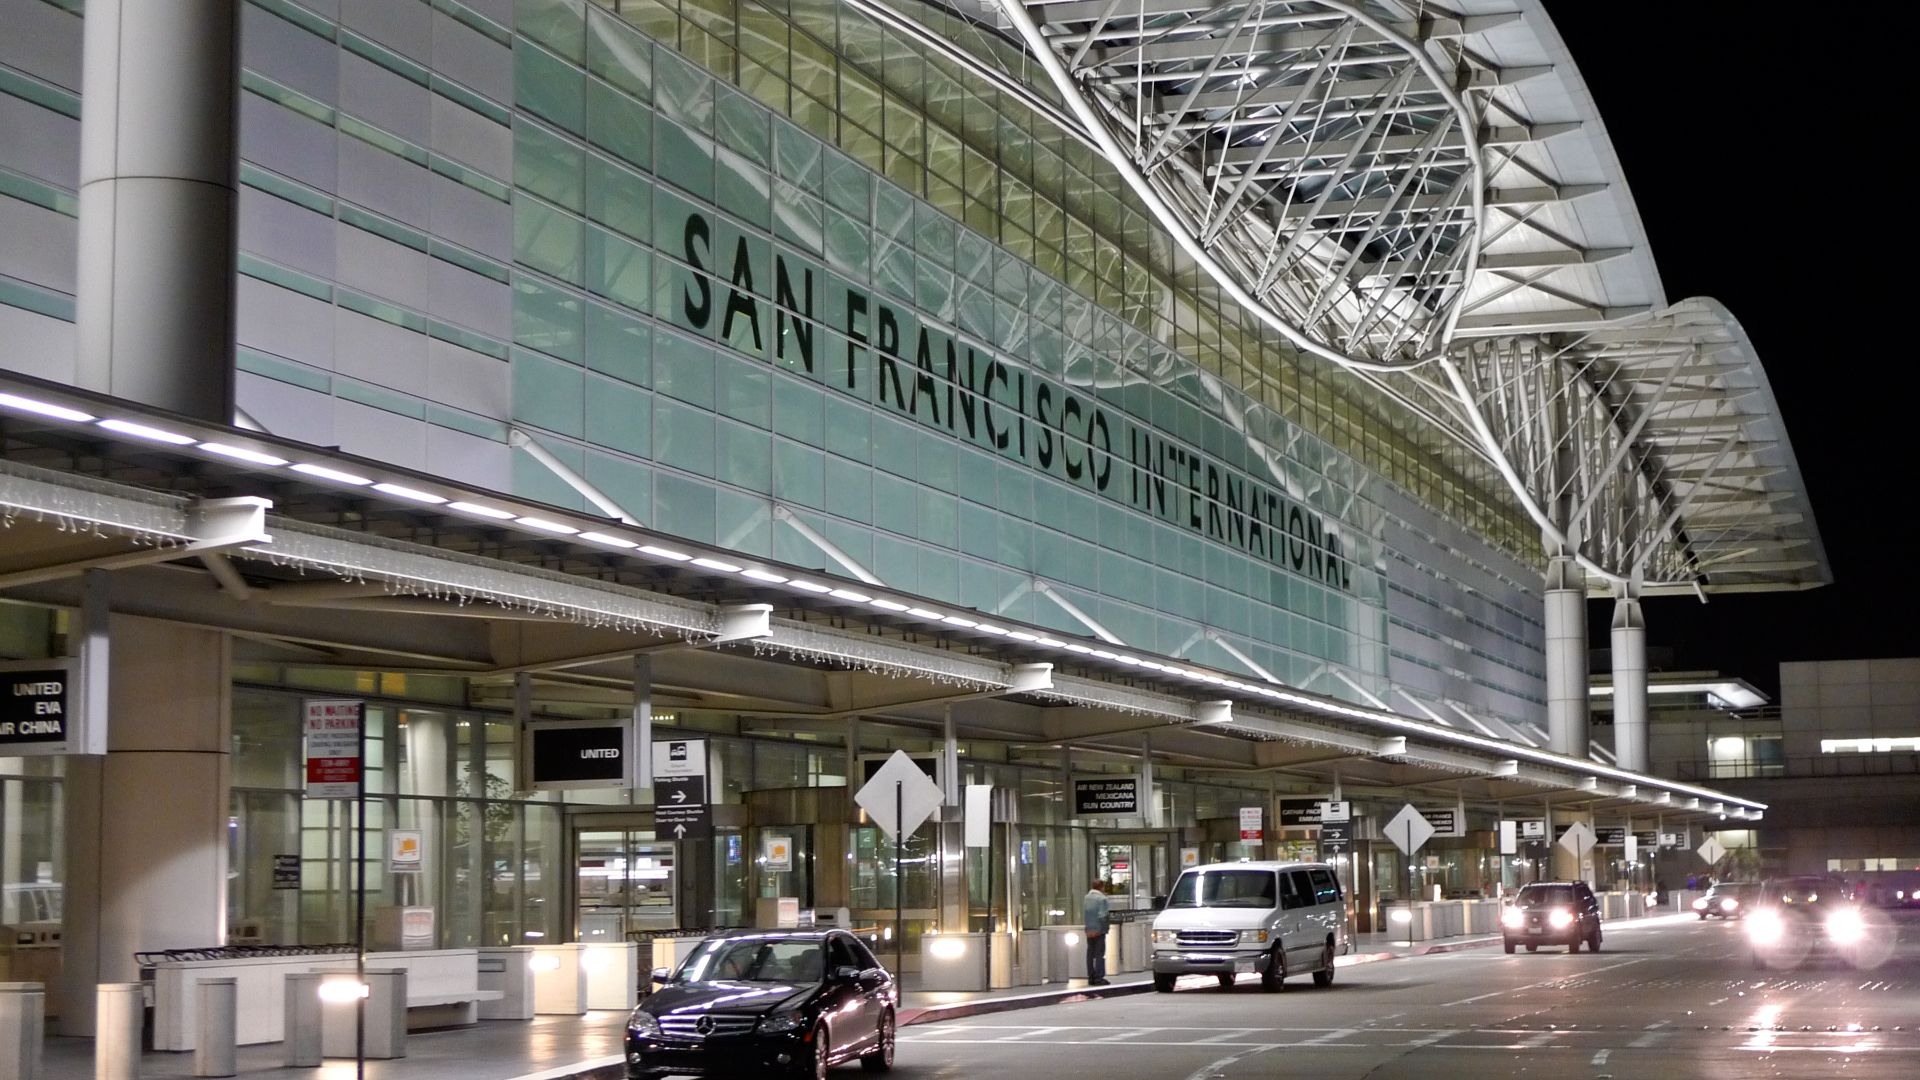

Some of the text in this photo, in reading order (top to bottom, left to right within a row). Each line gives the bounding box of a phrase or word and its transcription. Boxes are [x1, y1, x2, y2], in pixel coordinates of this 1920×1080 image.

[684, 213, 1350, 590] SAN FRANCISCO INTERNATIONAL
[14, 682, 63, 696] UNITED
[35, 701, 62, 715] EVA
[19, 720, 62, 735] CHINA
[325, 718, 360, 730] PARKIN
[580, 748, 620, 759] UNITED
[1088, 783, 1104, 791] NEW
[1105, 783, 1134, 791] ZEALAND
[1100, 801, 1134, 809] COUNTRY
